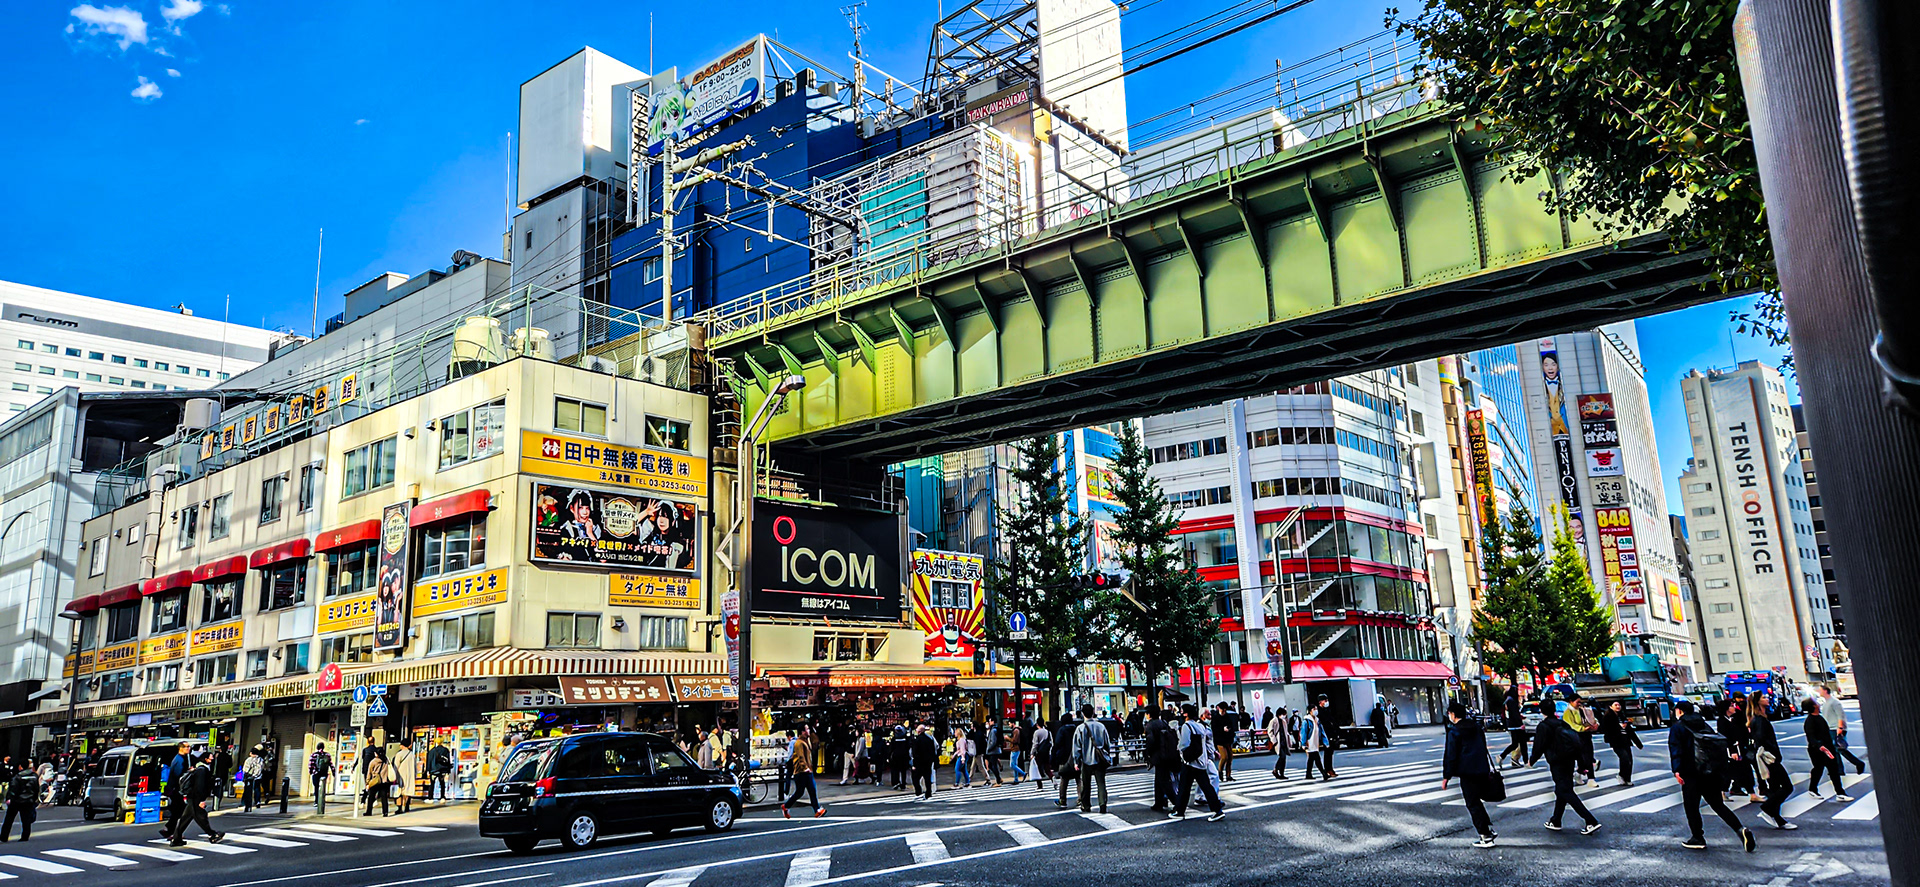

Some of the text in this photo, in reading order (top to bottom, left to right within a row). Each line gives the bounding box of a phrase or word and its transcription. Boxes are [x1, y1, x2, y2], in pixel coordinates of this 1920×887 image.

[692, 40, 757, 85] GAMERS
[967, 89, 1028, 122] TAKARADA
[599, 472, 699, 492] 法人営業 TEL 03-3253-4001
[1597, 509, 1630, 527] 848
[1618, 536, 1633, 545] 4階
[1621, 554, 1635, 562] 3階
[916, 557, 981, 580] 九州電気
[1624, 570, 1638, 578] 2階
[430, 573, 498, 600] ミツワデンキ
[624, 582, 687, 597] タイガー無線
[801, 597, 850, 610] 無線はアイコム
[415, 685, 456, 697] ミツワデンキ
[572, 686, 660, 700] ミツワデンキ
